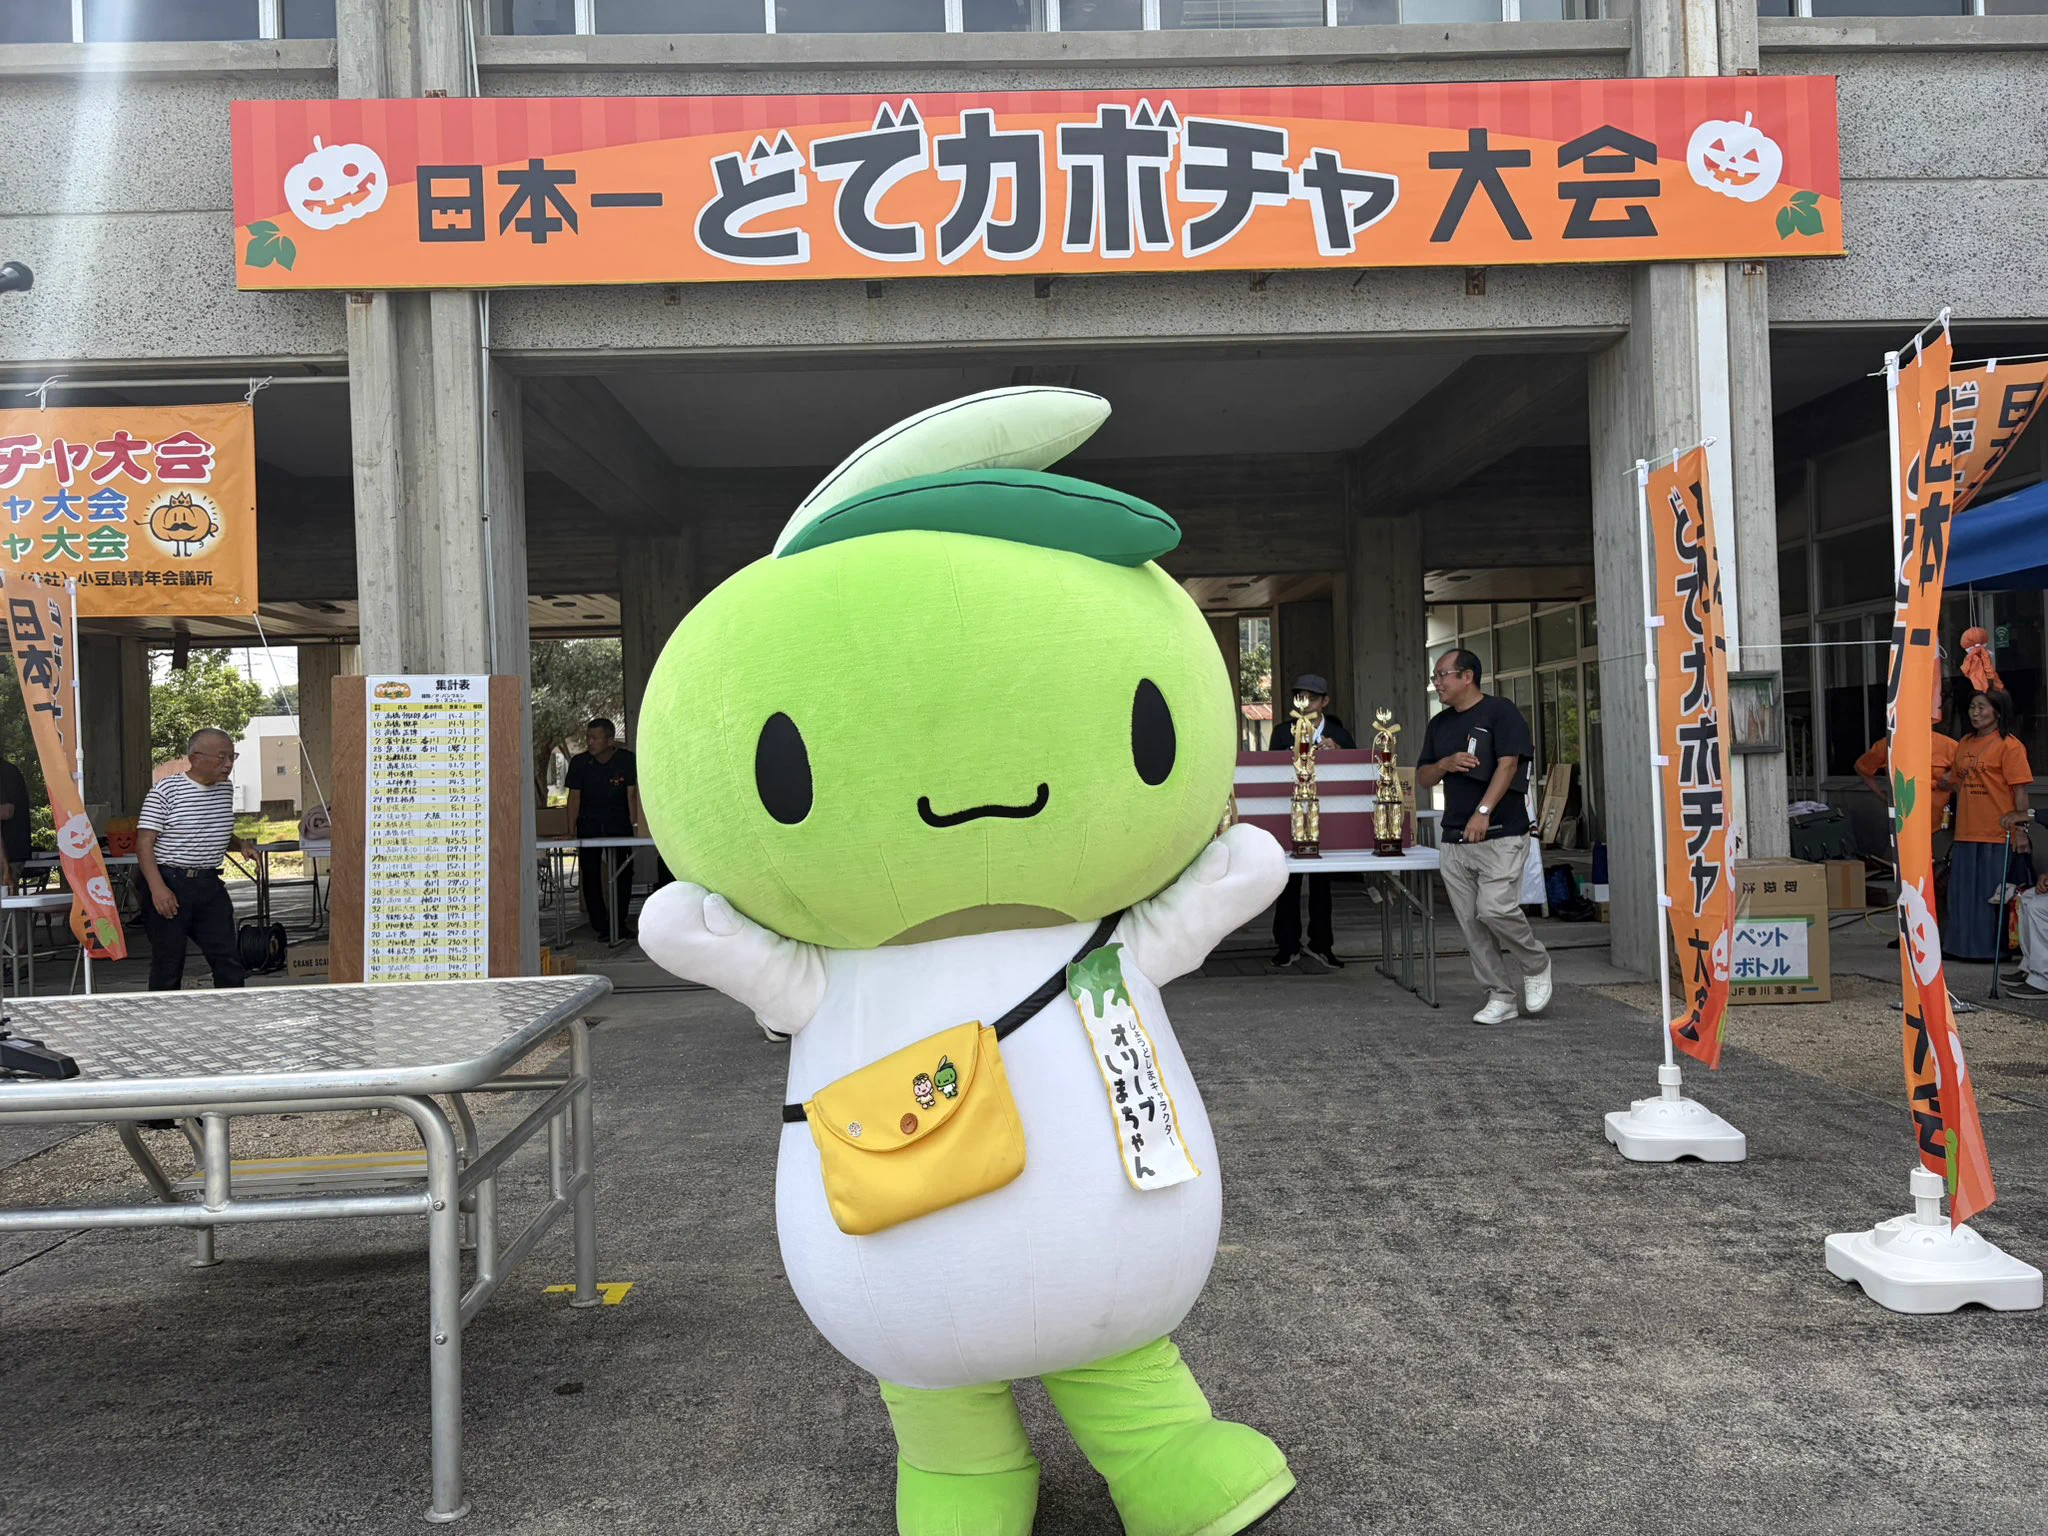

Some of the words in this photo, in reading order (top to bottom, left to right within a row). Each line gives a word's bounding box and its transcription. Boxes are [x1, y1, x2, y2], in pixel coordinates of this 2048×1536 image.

[416, 158, 663, 244] 日本一
[694, 97, 1399, 265] どてカボチャ
[1428, 124, 1660, 243] 大会
[436, 679, 470, 690] 集計表
[448, 727, 465, 735] 21.1
[449, 770, 464, 778] 9.5
[1736, 927, 1789, 947] ペット
[1735, 957, 1791, 977] ボトル
[1110, 1023, 1156, 1123] オリーブ
[1104, 1054, 1156, 1179] しまちゃん
